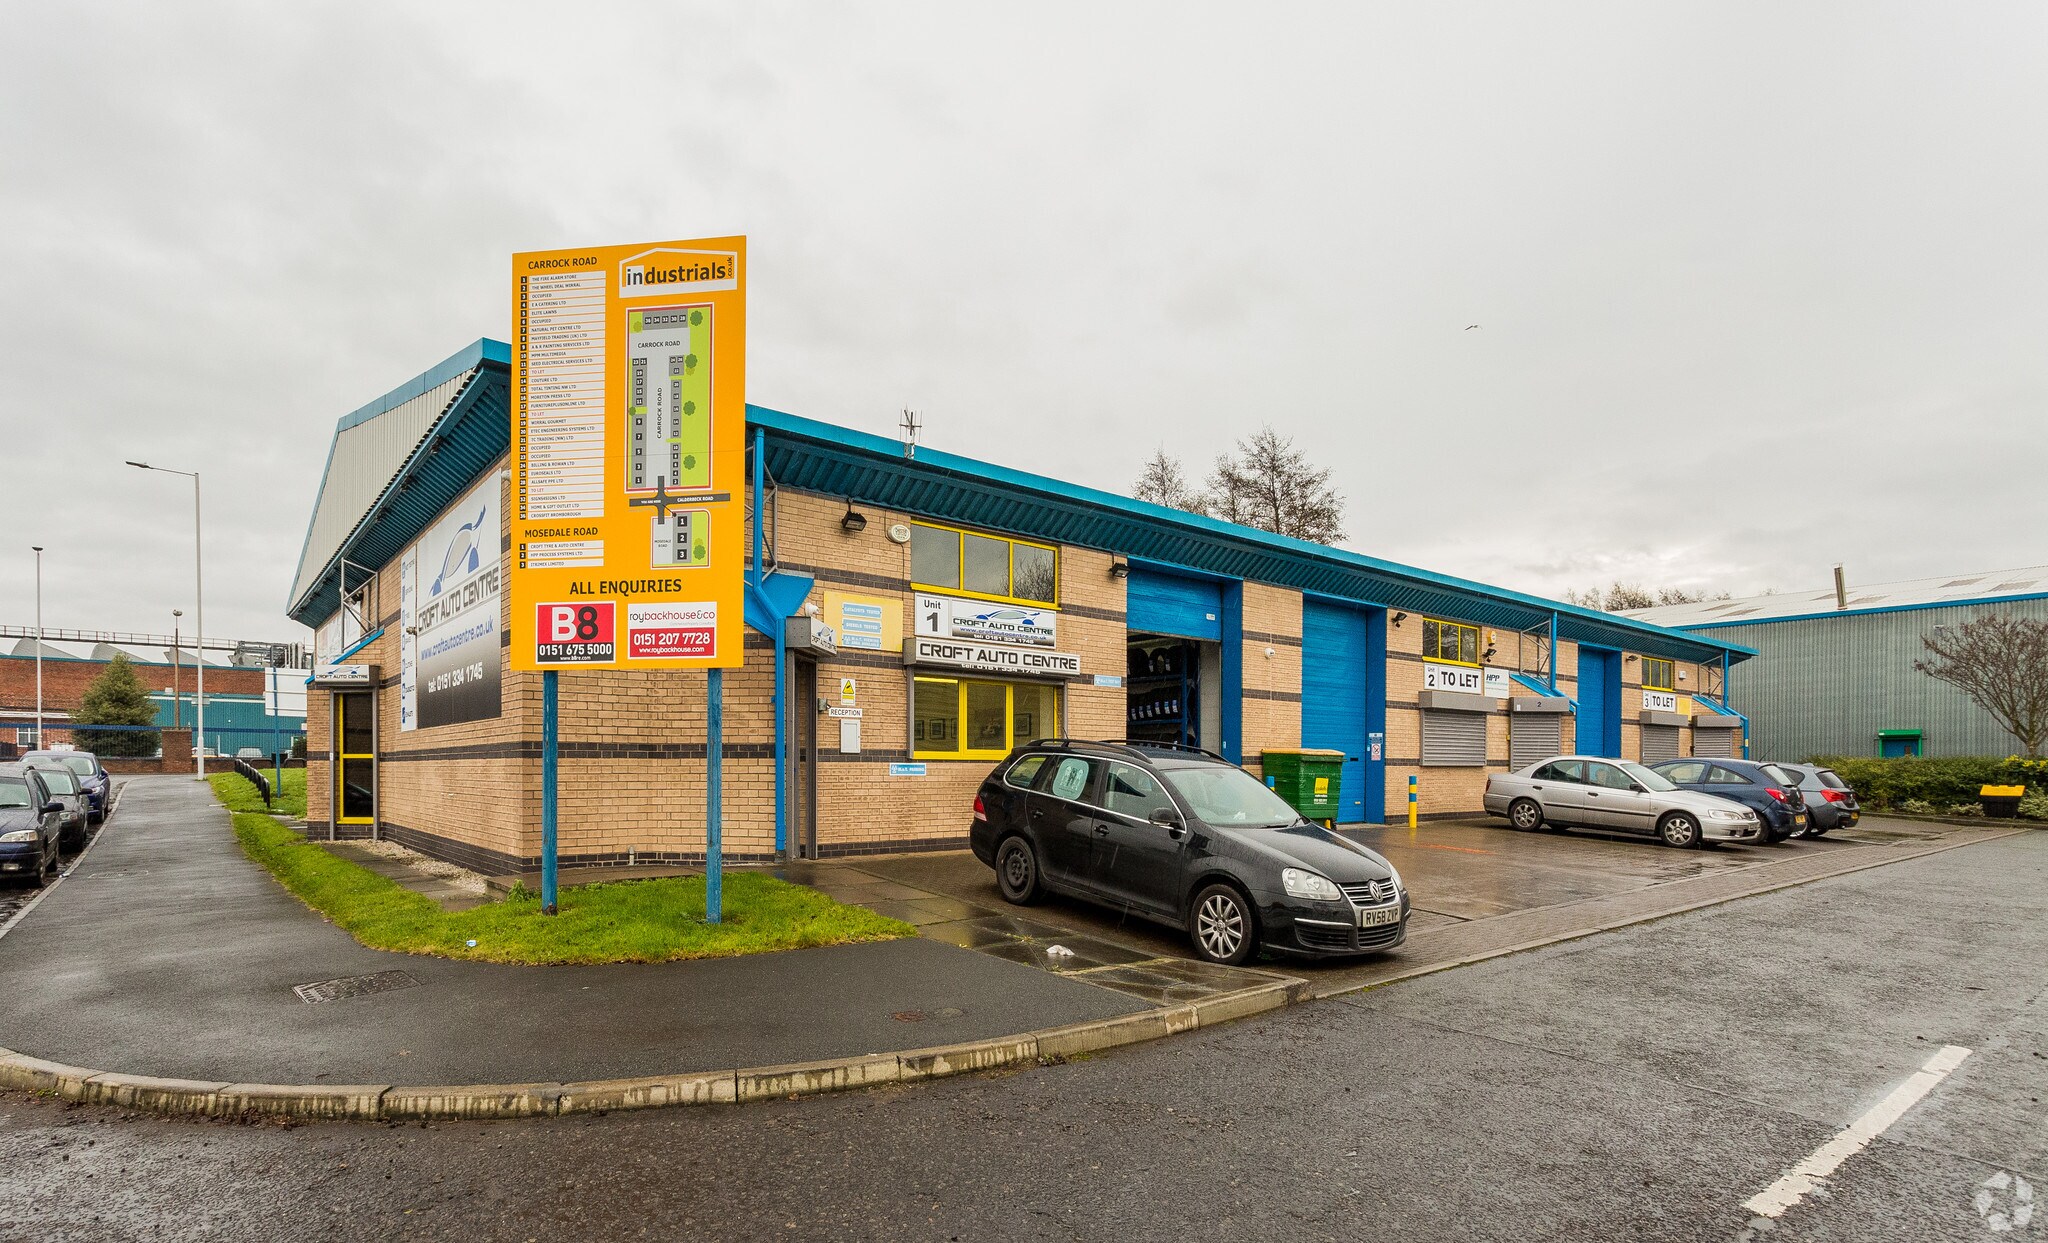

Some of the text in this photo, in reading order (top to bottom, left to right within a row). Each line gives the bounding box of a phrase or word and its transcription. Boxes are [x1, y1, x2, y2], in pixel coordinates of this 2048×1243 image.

[528, 257, 597, 269] CARROCK ROAD
[627, 262, 726, 285] industrials
[525, 527, 598, 538] MOSEDALE ROAD
[570, 579, 682, 596] ALL ENQUIRIES
[419, 566, 499, 631] CROFT AUTO CENTRE
[924, 600, 941, 610] Unit
[551, 606, 598, 641] B8
[630, 610, 715, 623] roybackhouse&co
[926, 612, 938, 632] 1
[953, 618, 1053, 635] CROFT AUTO CENTRE
[960, 627, 1047, 640] www.croftautocentre.co.uk
[421, 615, 494, 660] www.croftautocentre.co.uk
[633, 632, 711, 645] 0151 207 7728
[540, 643, 612, 655] 0151 675 5000
[639, 646, 704, 654] www.roybackhouse.com
[920, 643, 1077, 670] CROFT AUTO CENTRE
[437, 671, 451, 691] 0151
[466, 662, 483, 683] 1745
[1428, 674, 1435, 687] 2
[1441, 672, 1479, 688] TO LET
[1645, 698, 1649, 707] 3
[1652, 696, 1674, 708] TO LET
[1366, 909, 1398, 925] RV58 ZVP
